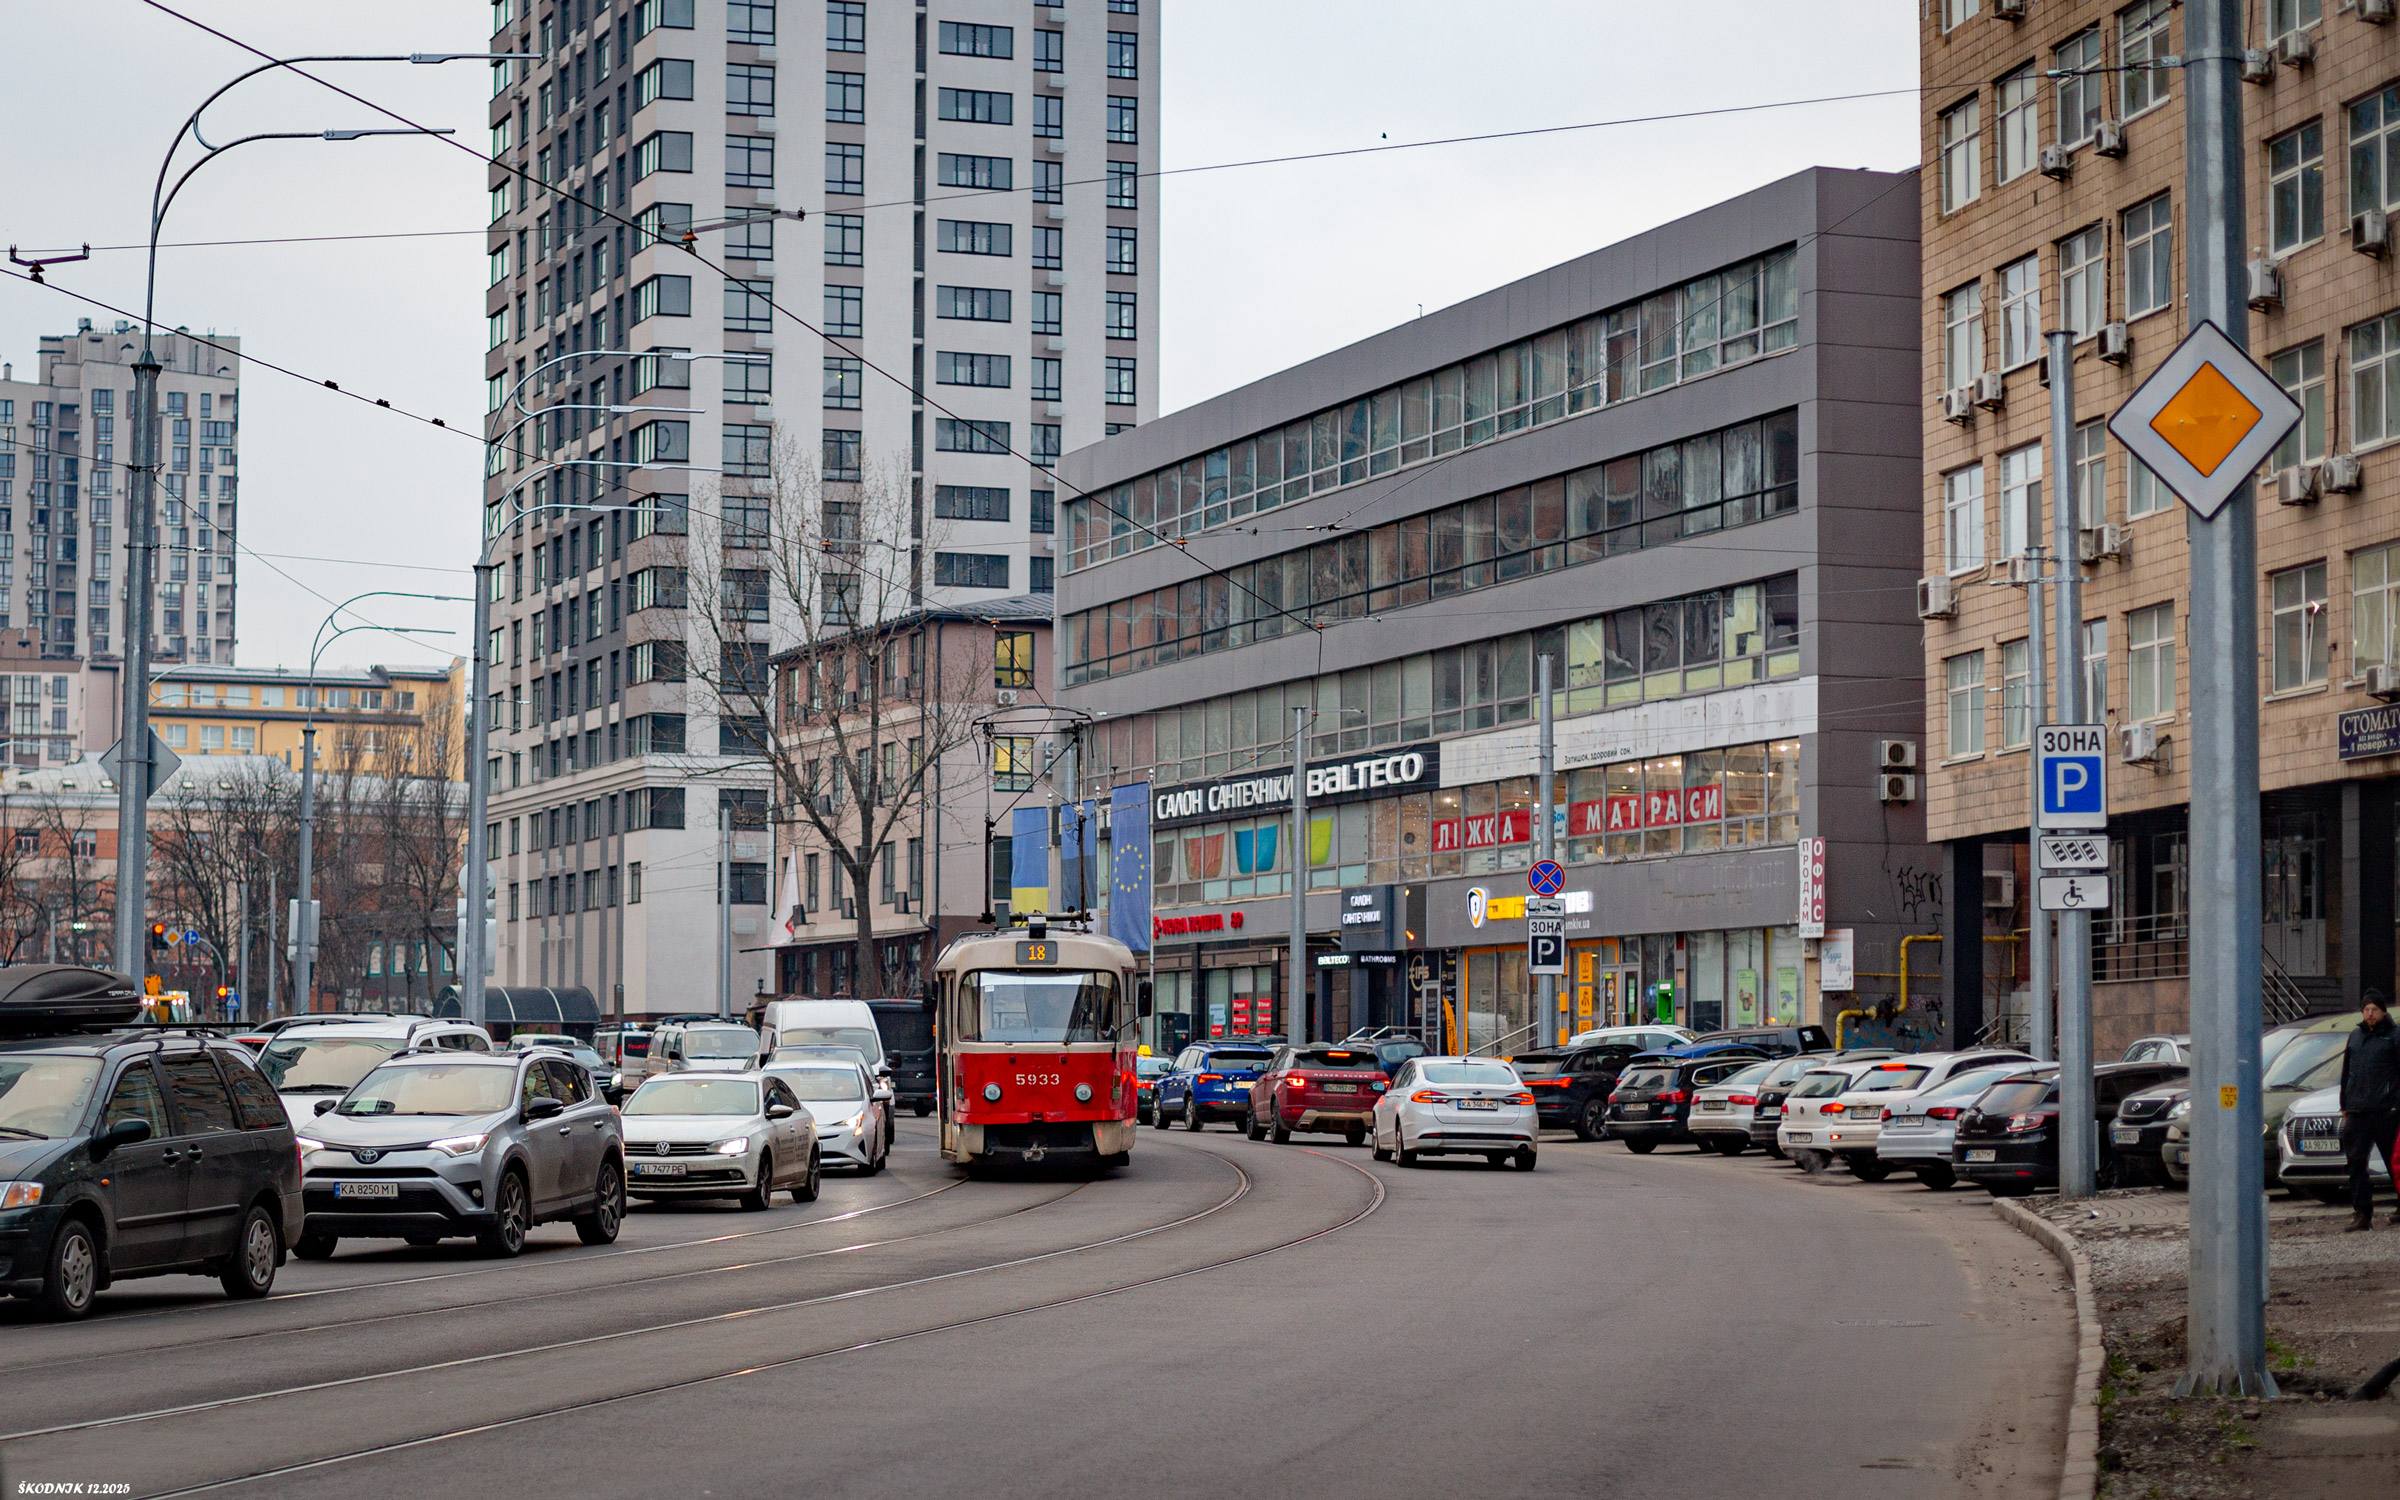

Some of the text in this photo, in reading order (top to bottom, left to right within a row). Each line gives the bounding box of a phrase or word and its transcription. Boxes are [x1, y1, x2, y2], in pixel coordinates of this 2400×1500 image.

[2342, 709, 2400, 736] СТОМАТ
[2043, 731, 2102, 752] ЗОНА
[1156, 774, 1294, 820] САЛОН САНТЕХНІКИ
[1586, 788, 1718, 832] МАТРАСИ
[1438, 815, 1514, 849] ЛІЖКА
[1812, 840, 1824, 921] ОФИС
[1350, 894, 1372, 907] САЛОН
[1531, 921, 1562, 933] ЗОНА
[1028, 944, 1046, 961] 18
[1015, 1073, 1060, 1086] 5933
[640, 1165, 684, 1174] AI 7477 PE
[341, 1185, 395, 1195] KA 8250 MI
